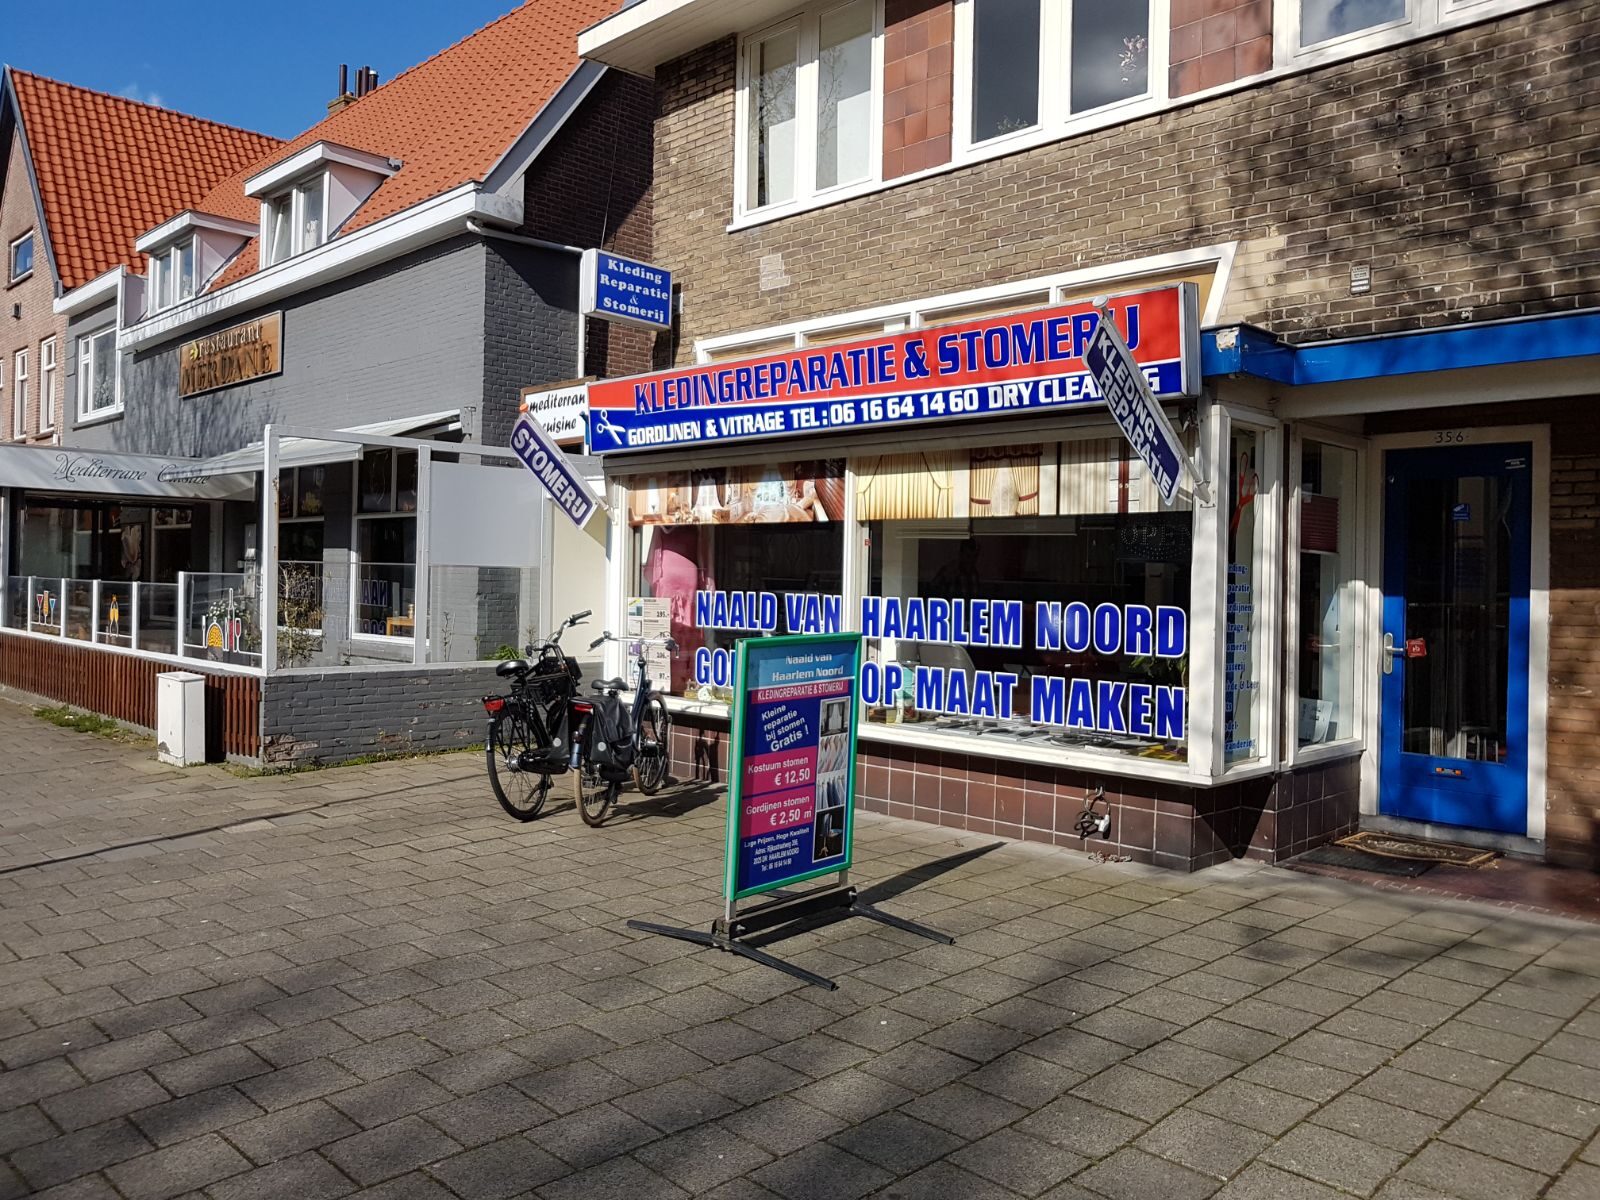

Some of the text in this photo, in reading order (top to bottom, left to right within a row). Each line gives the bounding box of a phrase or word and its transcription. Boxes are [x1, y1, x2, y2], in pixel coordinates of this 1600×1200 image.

[607, 259, 662, 285] Kleding
[600, 273, 668, 301] Reparatie
[629, 294, 639, 305] &
[603, 297, 665, 323] Stomerij
[199, 322, 261, 358] restaurant
[181, 341, 273, 396] MERDANE
[634, 304, 1141, 416] KLEDINGREPARATIE & STOMERJ
[1097, 331, 1159, 446] KLEDING-
[627, 420, 702, 447] GORDIJNEN
[705, 418, 718, 438] &
[721, 410, 786, 436] VITRAGE
[862, 398, 885, 422] 16
[886, 396, 915, 419] 64
[921, 392, 945, 416] 14
[949, 388, 979, 413] 60
[988, 381, 1034, 408] DRY
[1099, 367, 1173, 496] REPARATIE
[1435, 431, 1464, 443] 356
[53, 452, 147, 483] Mediterrane
[513, 428, 588, 519] STOMERIJ
[696, 590, 1187, 659] NAALD VAN HAARLEM NOORD
[785, 653, 833, 665] Naald van
[771, 666, 844, 682] Haarlem Noord
[757, 684, 844, 701] KLEDINGREPARATIE & STOMERIJ
[860, 661, 904, 708] OP
[914, 665, 1018, 720] MAAT
[1030, 674, 1186, 740] MAKEN
[761, 704, 787, 721] Kleine
[763, 709, 798, 732] reparatie
[765, 717, 806, 743] bij stomen
[770, 730, 803, 753] Gratis
[747, 756, 809, 774] Kostuum stomen
[774, 767, 811, 786] € 12,50
[746, 795, 810, 816] Gordijnen stomen
[769, 812, 777, 826] €
[779, 808, 801, 825] 2,50
